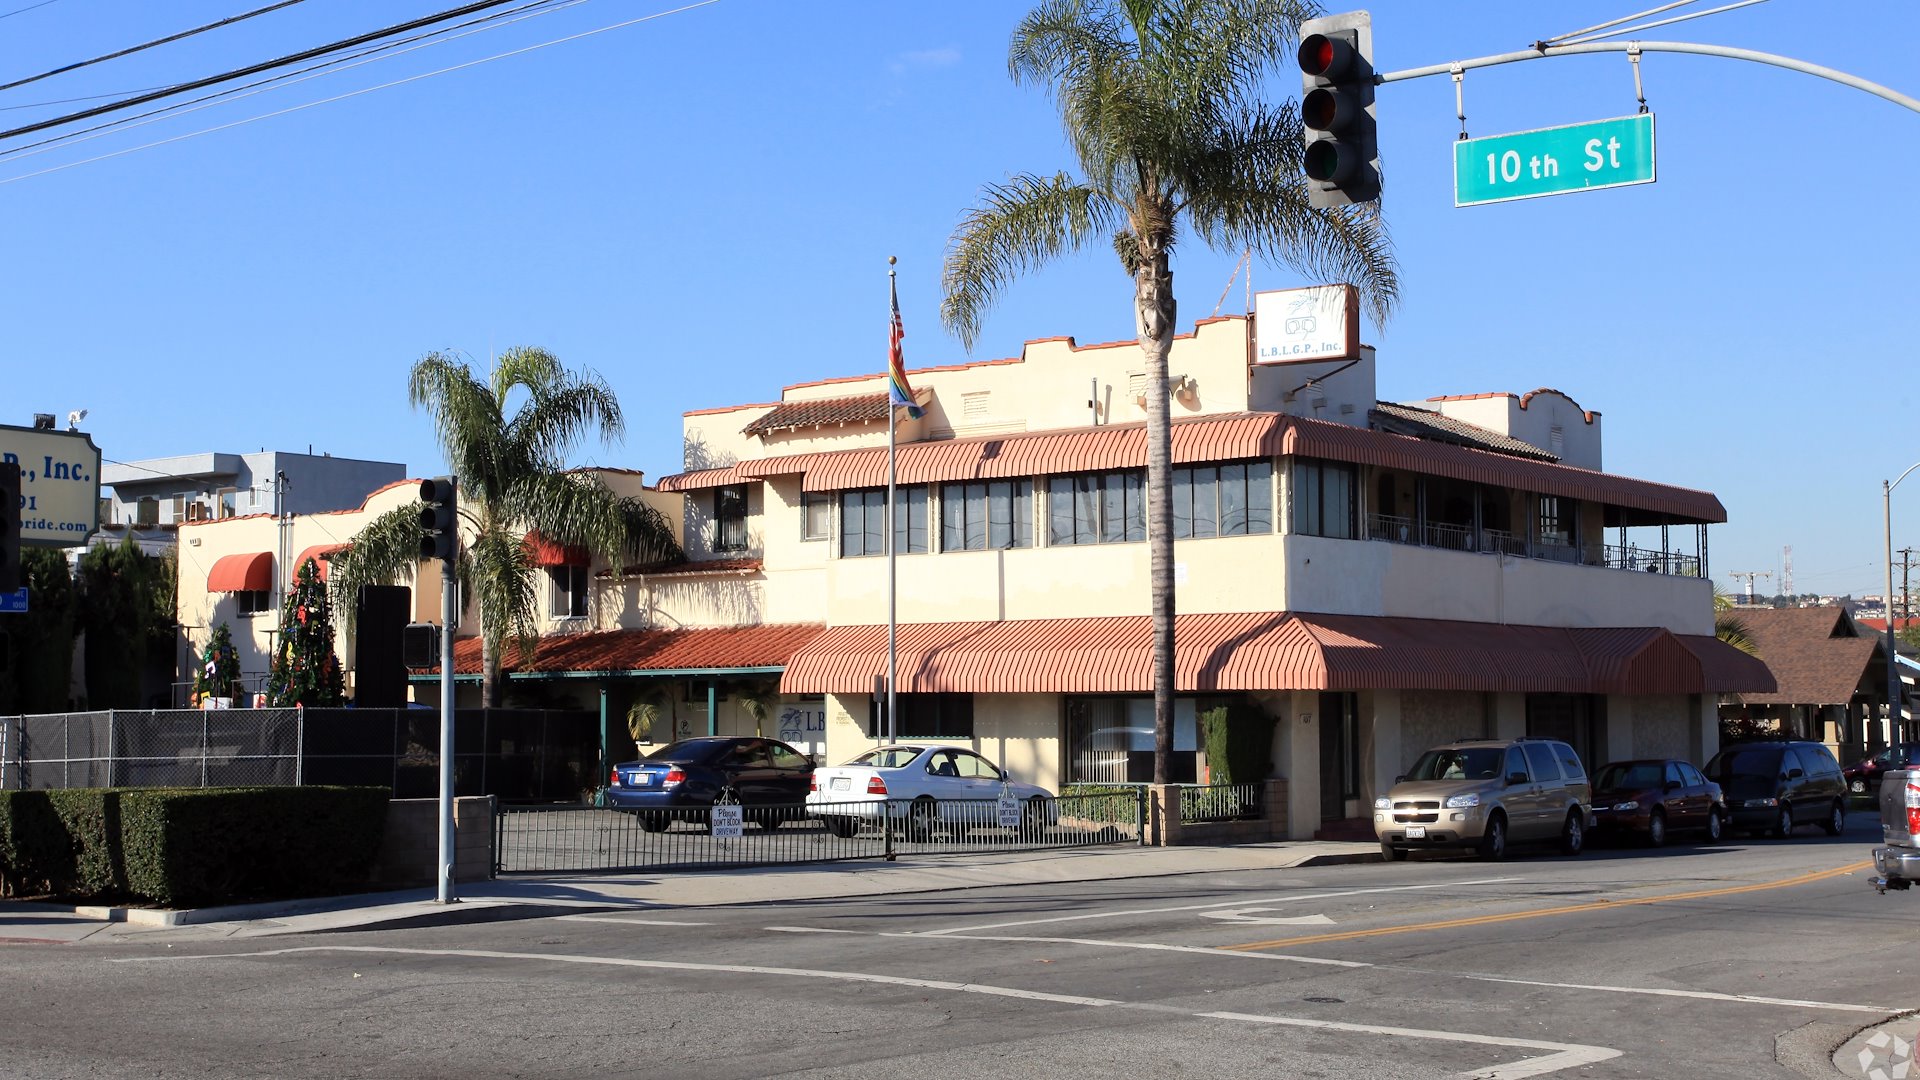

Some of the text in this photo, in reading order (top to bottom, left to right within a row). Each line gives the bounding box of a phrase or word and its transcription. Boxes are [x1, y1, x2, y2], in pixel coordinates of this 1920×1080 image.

[1487, 136, 1621, 185] 10th St
[1321, 342, 1342, 352] Inc.
[44, 455, 90, 482] Inc.
[718, 808, 737, 818] Please
[713, 818, 741, 827] DON'T BLOCK
[716, 827, 739, 836] DRIVEWAY
